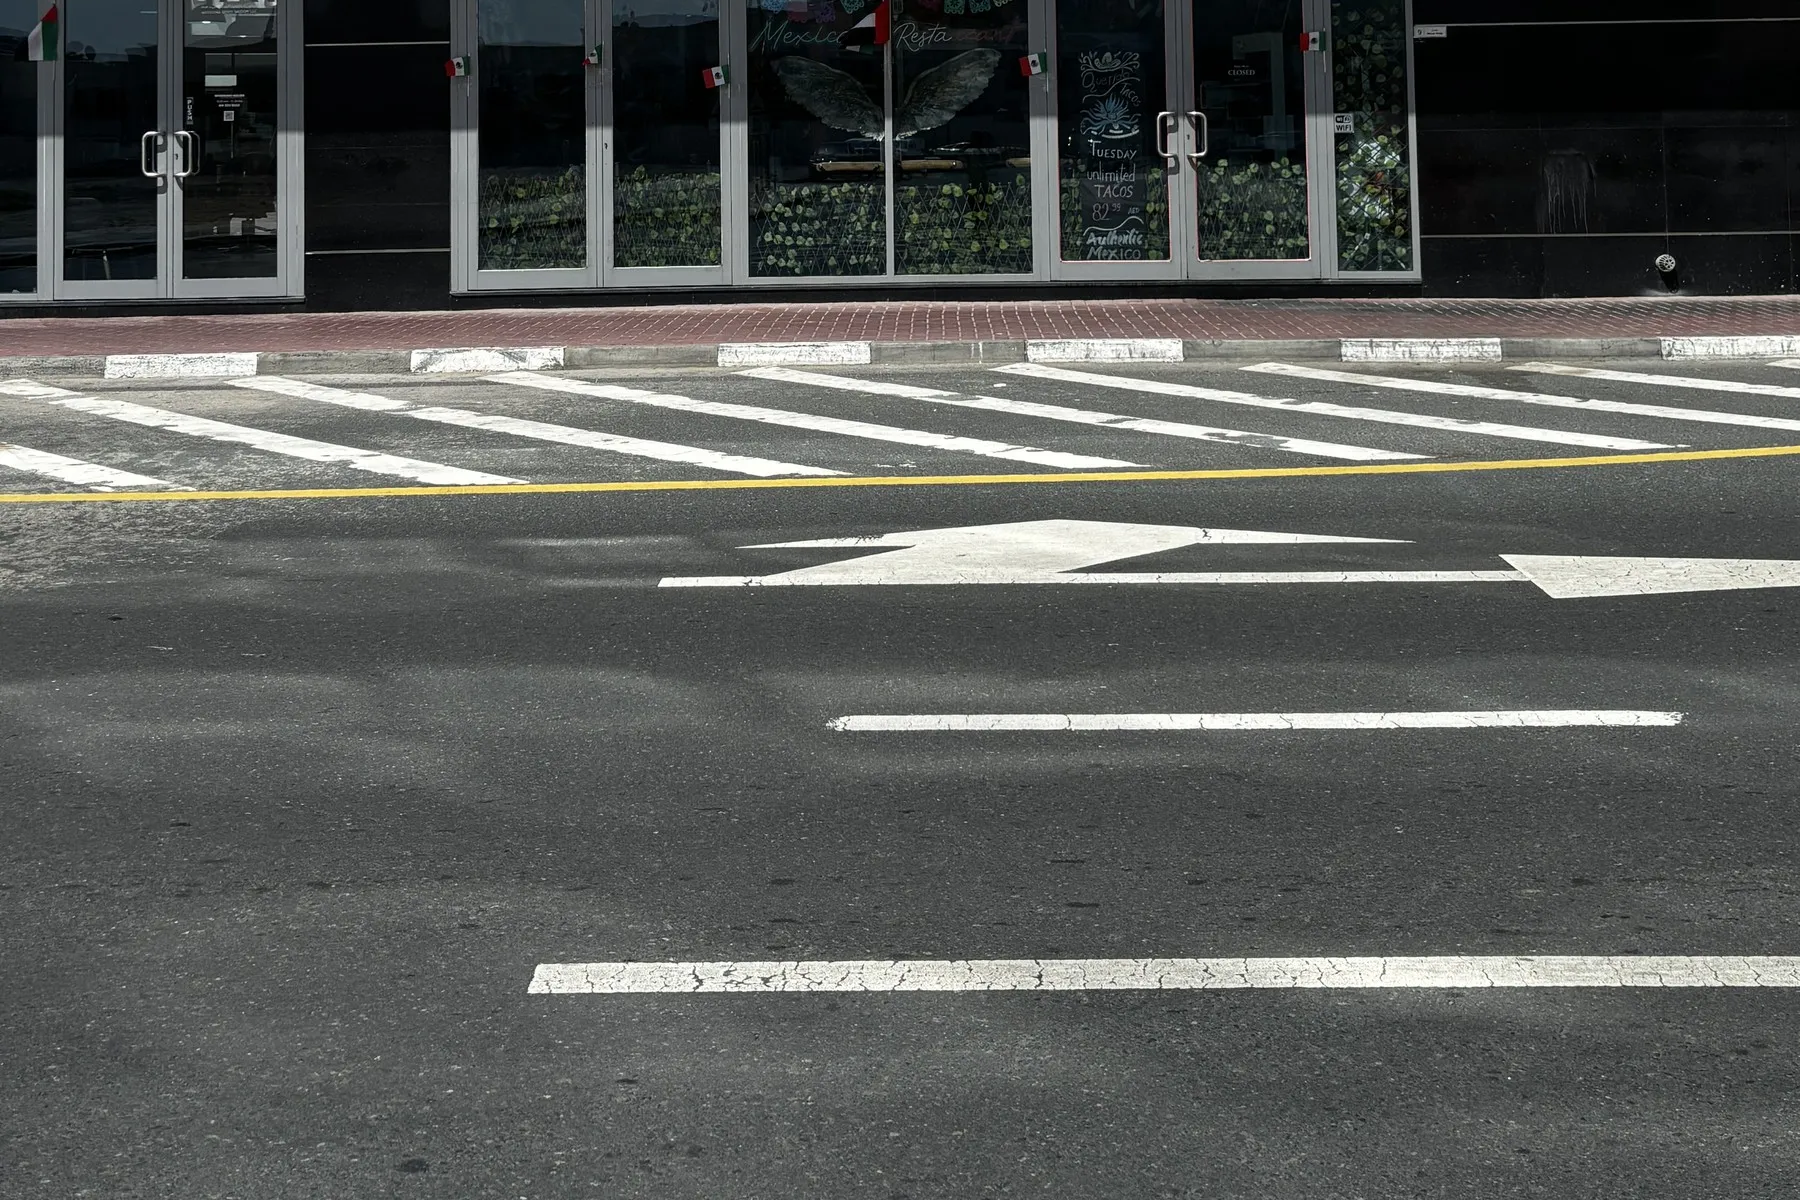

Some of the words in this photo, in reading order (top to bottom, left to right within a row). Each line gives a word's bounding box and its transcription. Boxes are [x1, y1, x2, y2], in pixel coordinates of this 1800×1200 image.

[1087, 161, 1136, 183] unlimited
[1094, 184, 1134, 198] TACOS
[1092, 203, 1110, 221] 82
